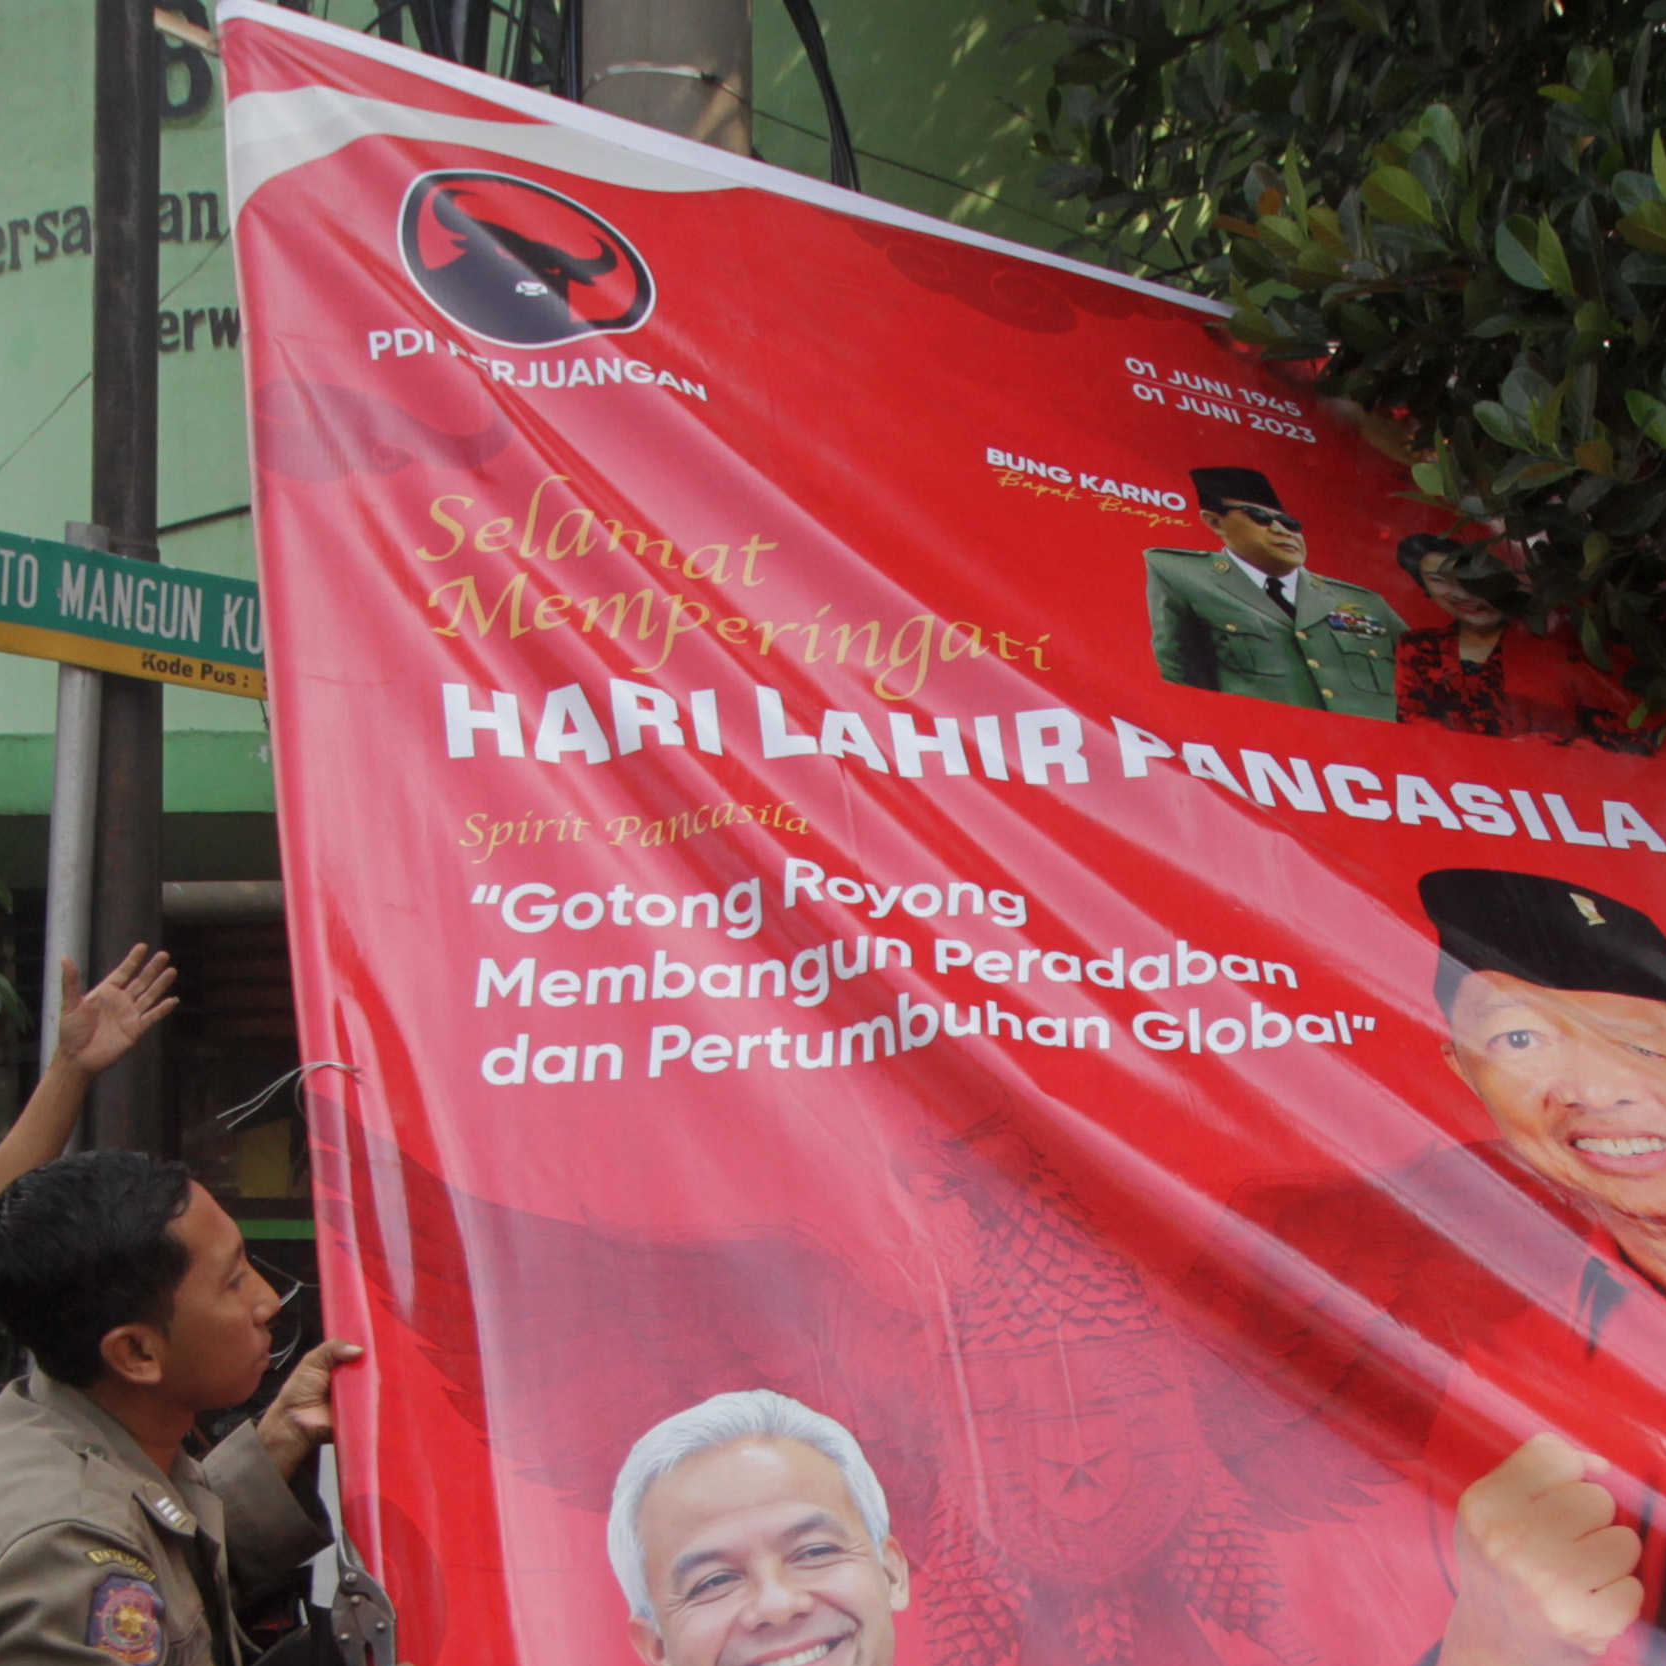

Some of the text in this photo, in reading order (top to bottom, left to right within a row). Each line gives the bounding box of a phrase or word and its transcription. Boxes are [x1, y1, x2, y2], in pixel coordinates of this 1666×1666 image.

[368, 327, 435, 360] PDI
[1125, 357, 1302, 417] 01 JUNI 1945
[1132, 383, 1317, 443] 01 JUNI 2023
[986, 447, 1187, 512] BUNG KARNO
[415, 475, 779, 587] Selamat
[59, 561, 202, 643] MANGUN
[222, 594, 266, 658] KU
[427, 571, 1051, 700] Memperingati
[142, 652, 193, 678] Kode
[201, 663, 237, 686] Pos
[441, 677, 723, 765] HARI
[755, 685, 1090, 785] LAHIR
[458, 801, 810, 865] Spirit Pancasila
[783, 857, 1027, 928] Royong
[475, 934, 1298, 1008] Membangun Peradaban
[481, 1033, 623, 1086] dan
[646, 993, 1111, 1078] Pertumbuhan
